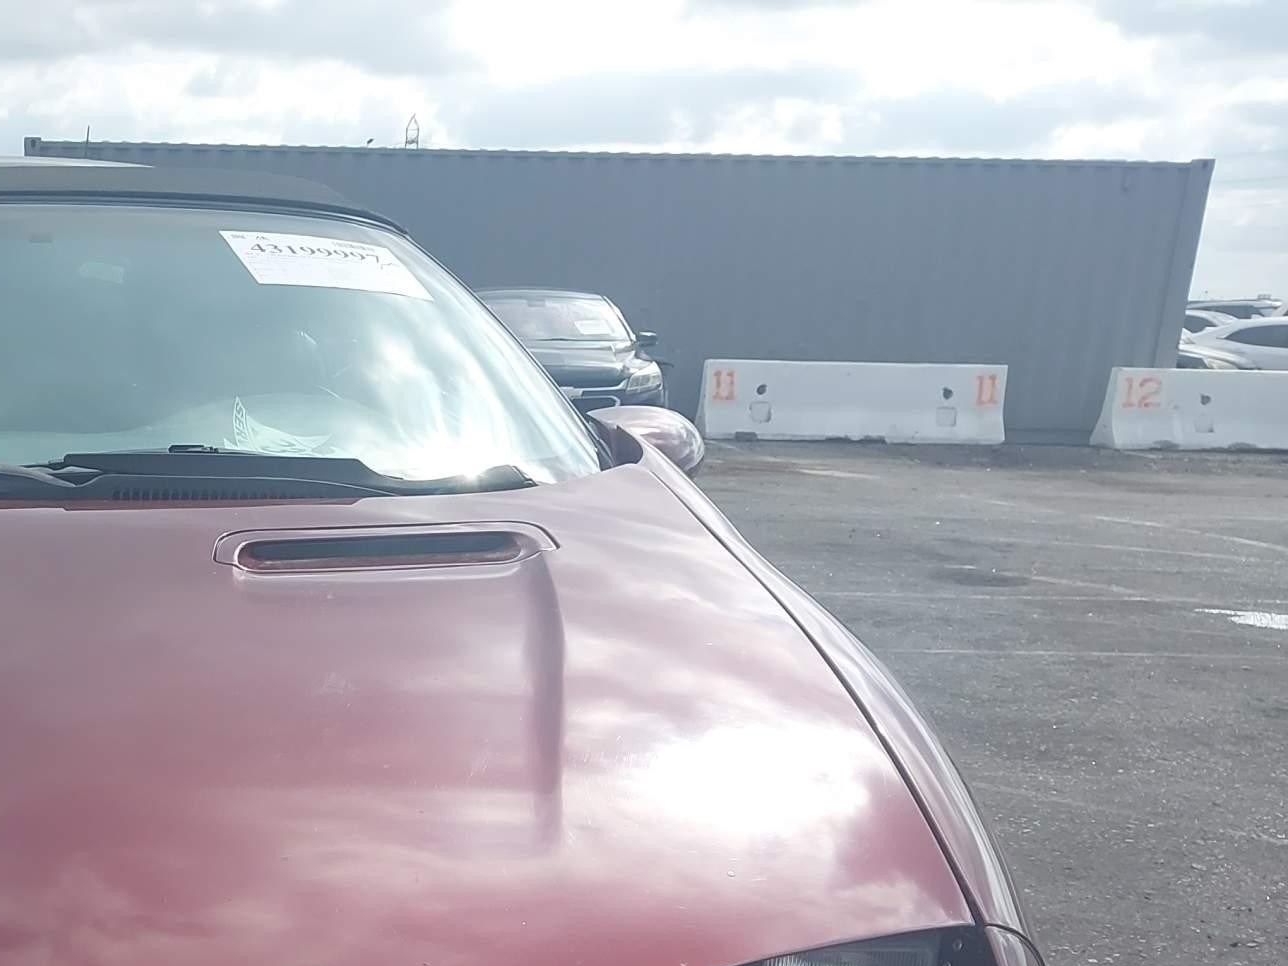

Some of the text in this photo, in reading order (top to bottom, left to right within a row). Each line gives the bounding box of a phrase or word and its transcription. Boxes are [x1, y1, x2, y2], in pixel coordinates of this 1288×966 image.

[713, 370, 735, 400] 11
[976, 374, 999, 406] 11
[1122, 376, 1162, 408] 12
